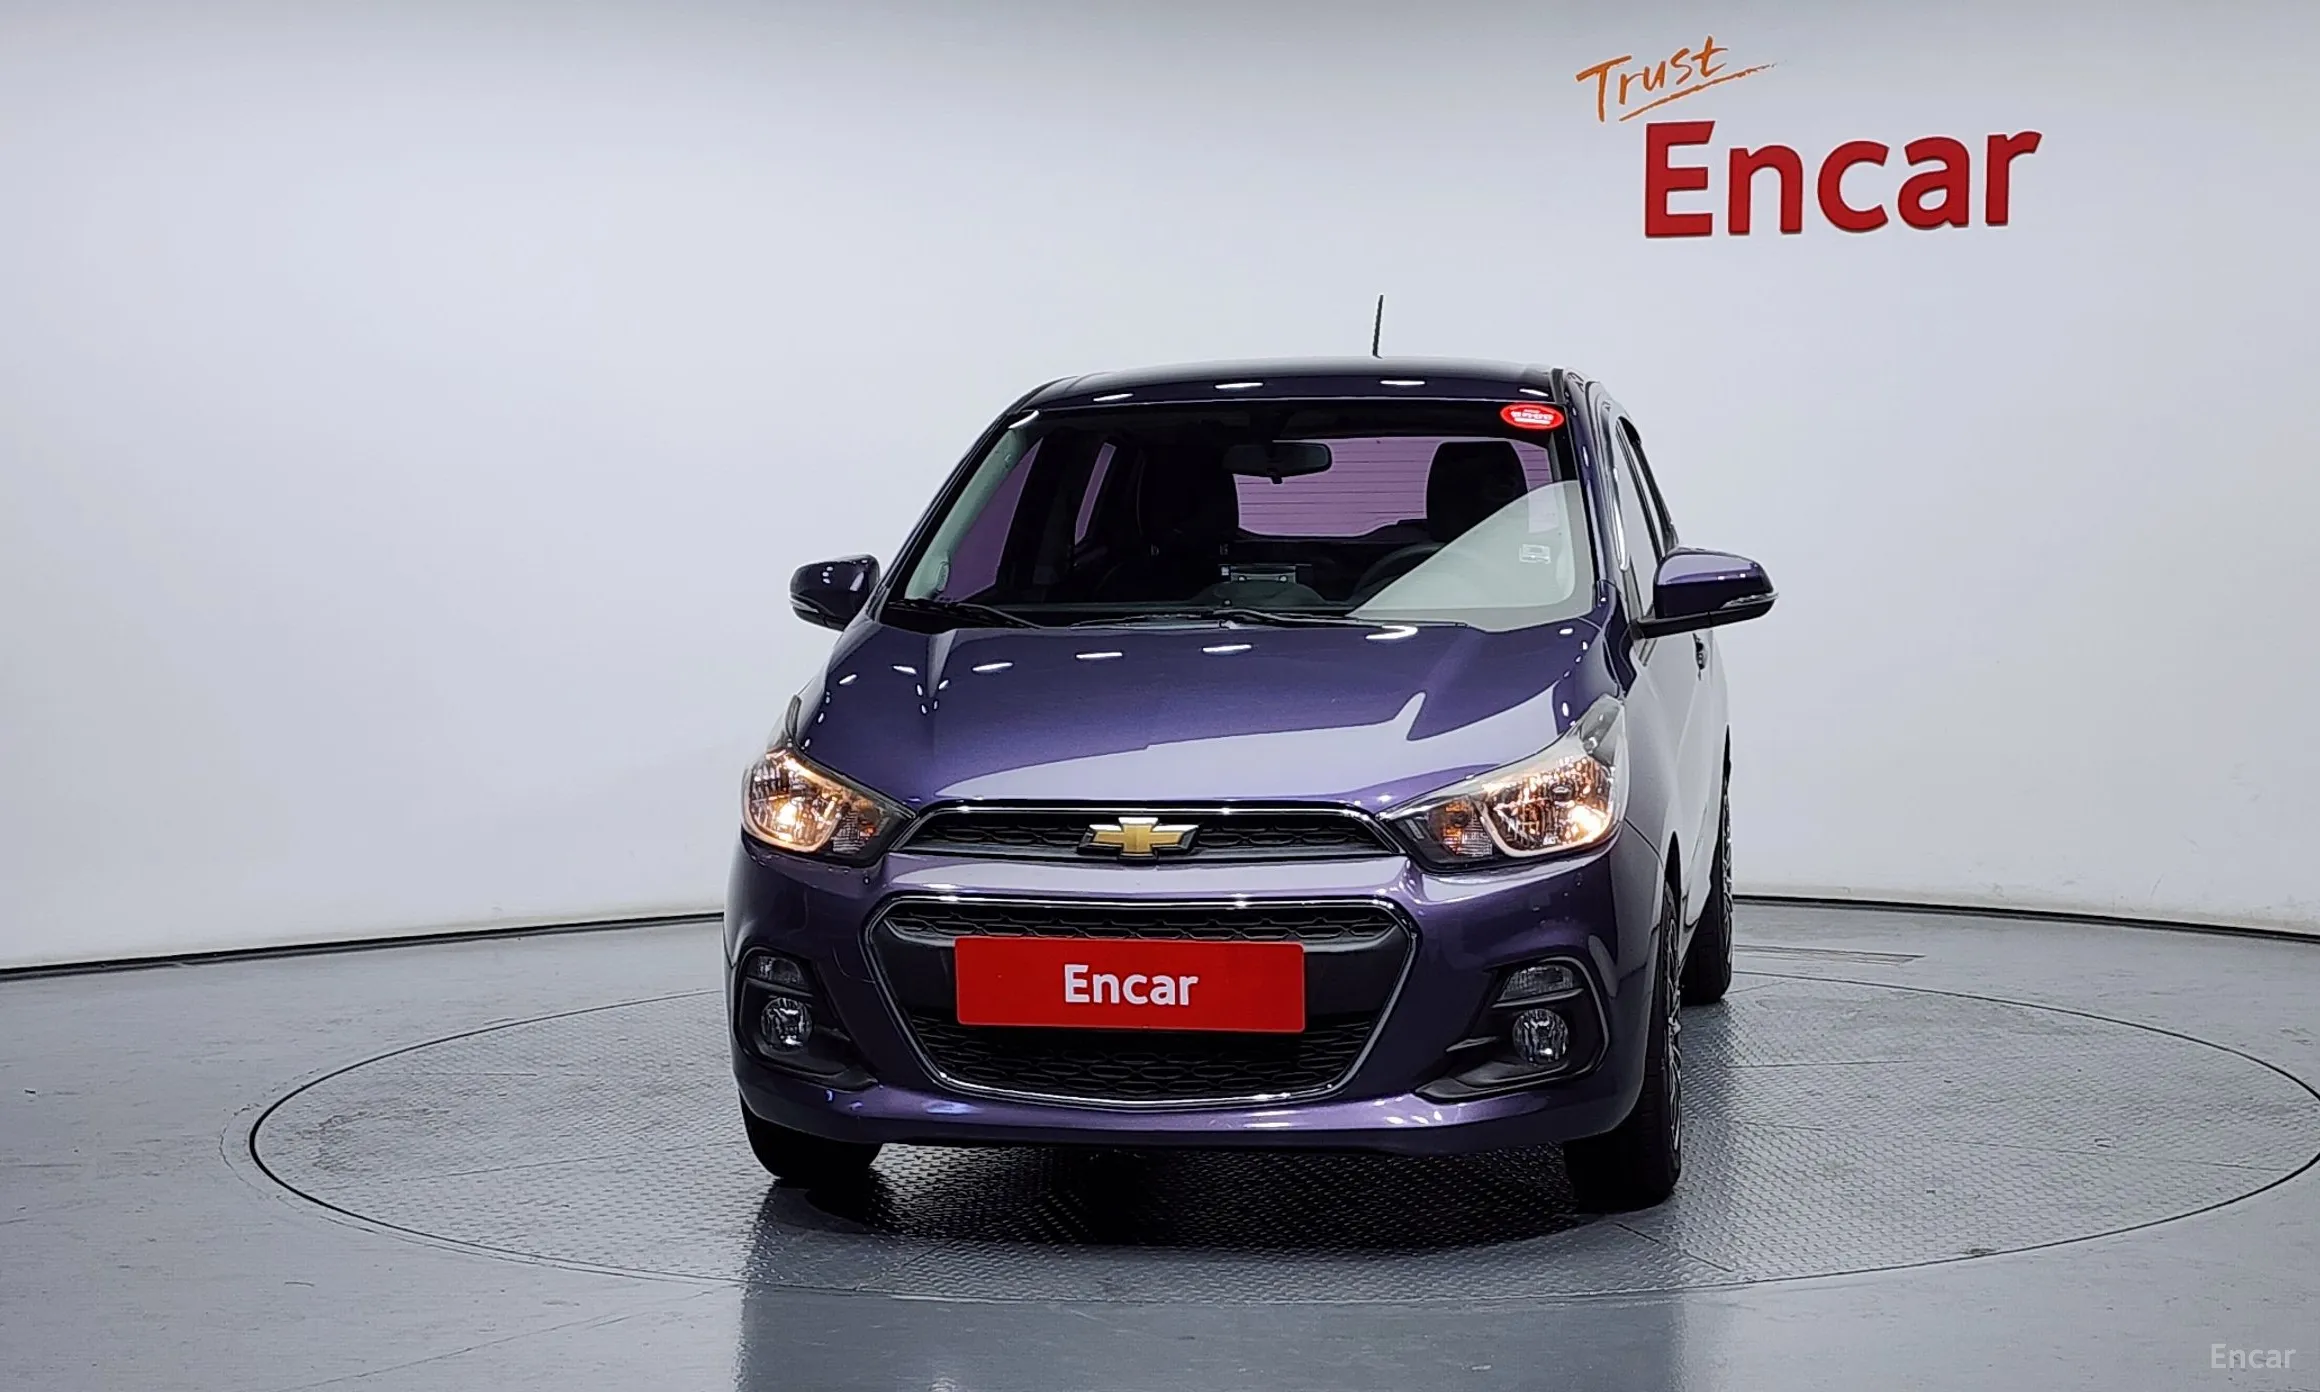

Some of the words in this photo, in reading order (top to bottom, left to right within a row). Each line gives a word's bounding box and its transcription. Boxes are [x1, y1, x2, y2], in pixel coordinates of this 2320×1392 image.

[1576, 36, 1729, 122] Trust
[1645, 121, 2042, 238] Encar
[1064, 964, 1198, 1005] Encar
